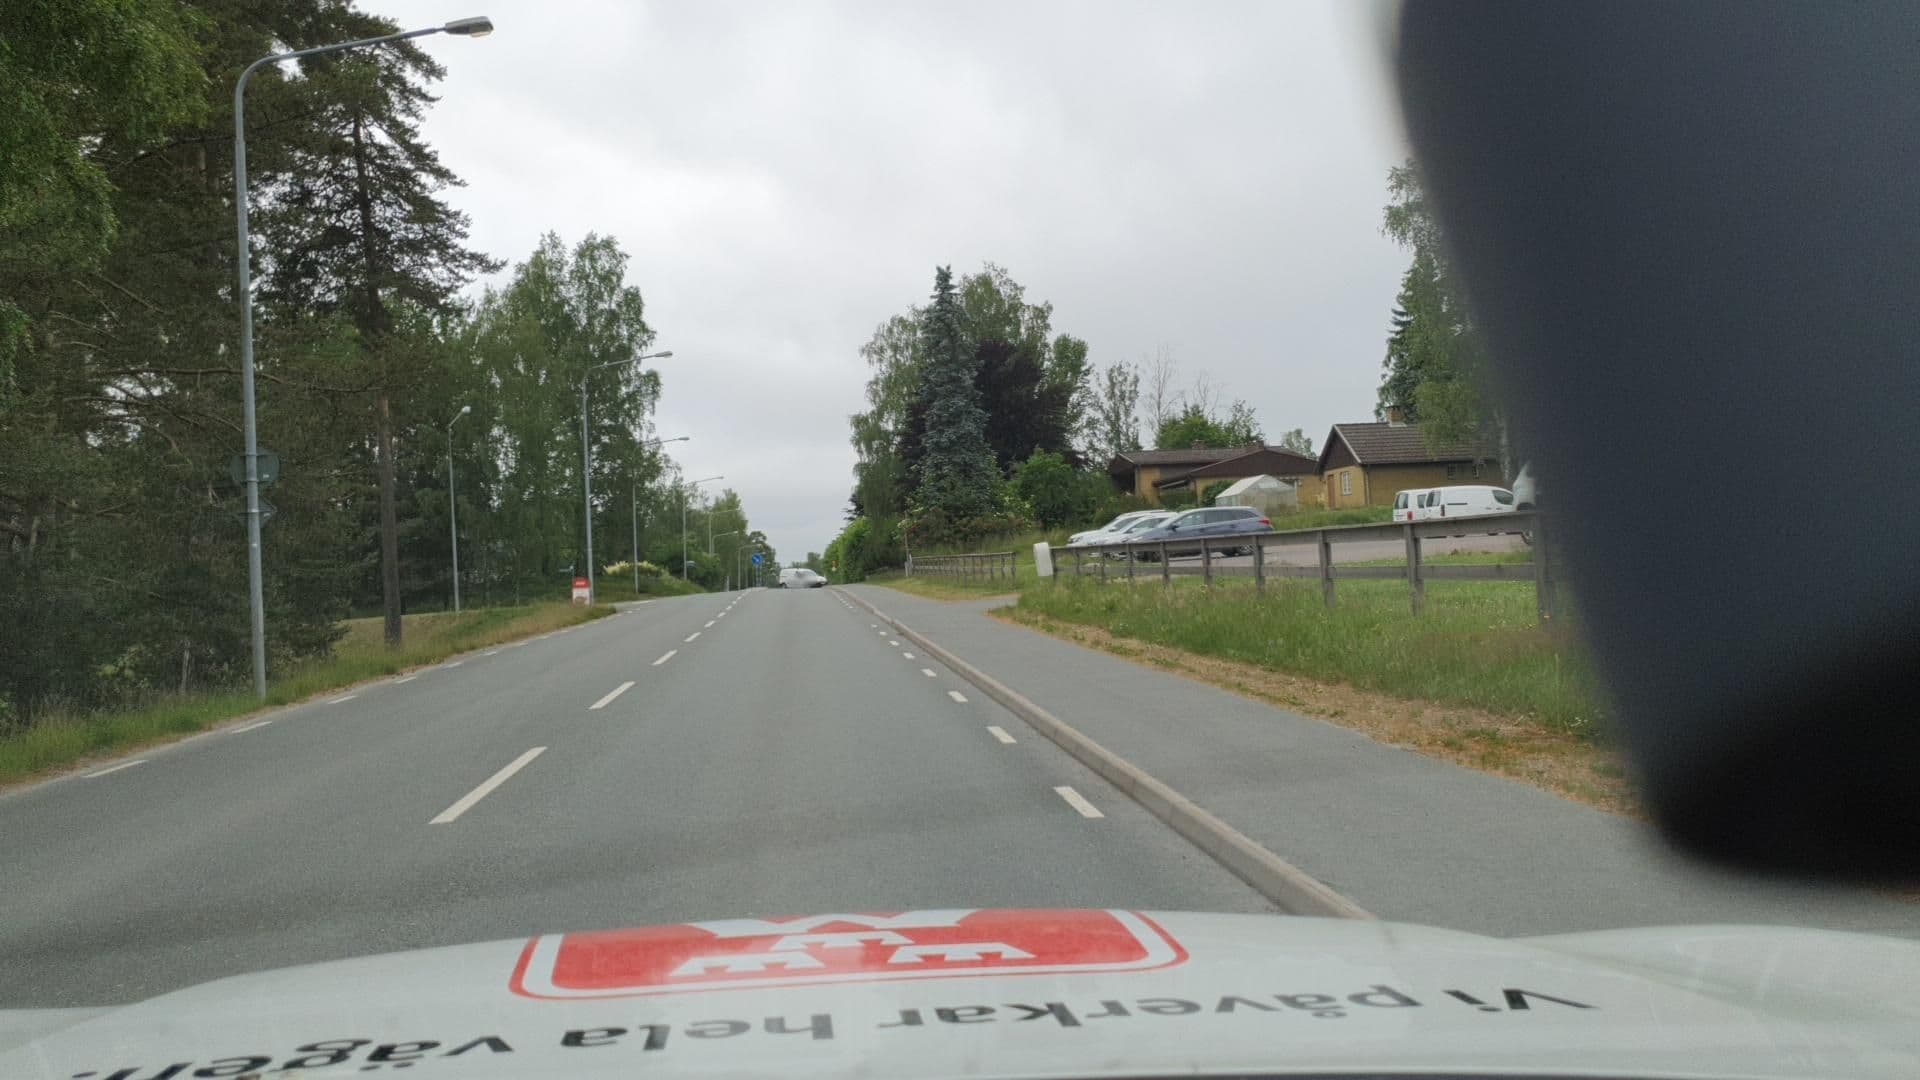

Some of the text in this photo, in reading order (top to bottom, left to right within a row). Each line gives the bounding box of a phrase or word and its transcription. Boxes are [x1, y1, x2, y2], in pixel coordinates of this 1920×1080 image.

[876, 984, 1424, 1029] påverkar
[1442, 987, 1600, 1012] Vi
[559, 1013, 834, 1051] hela
